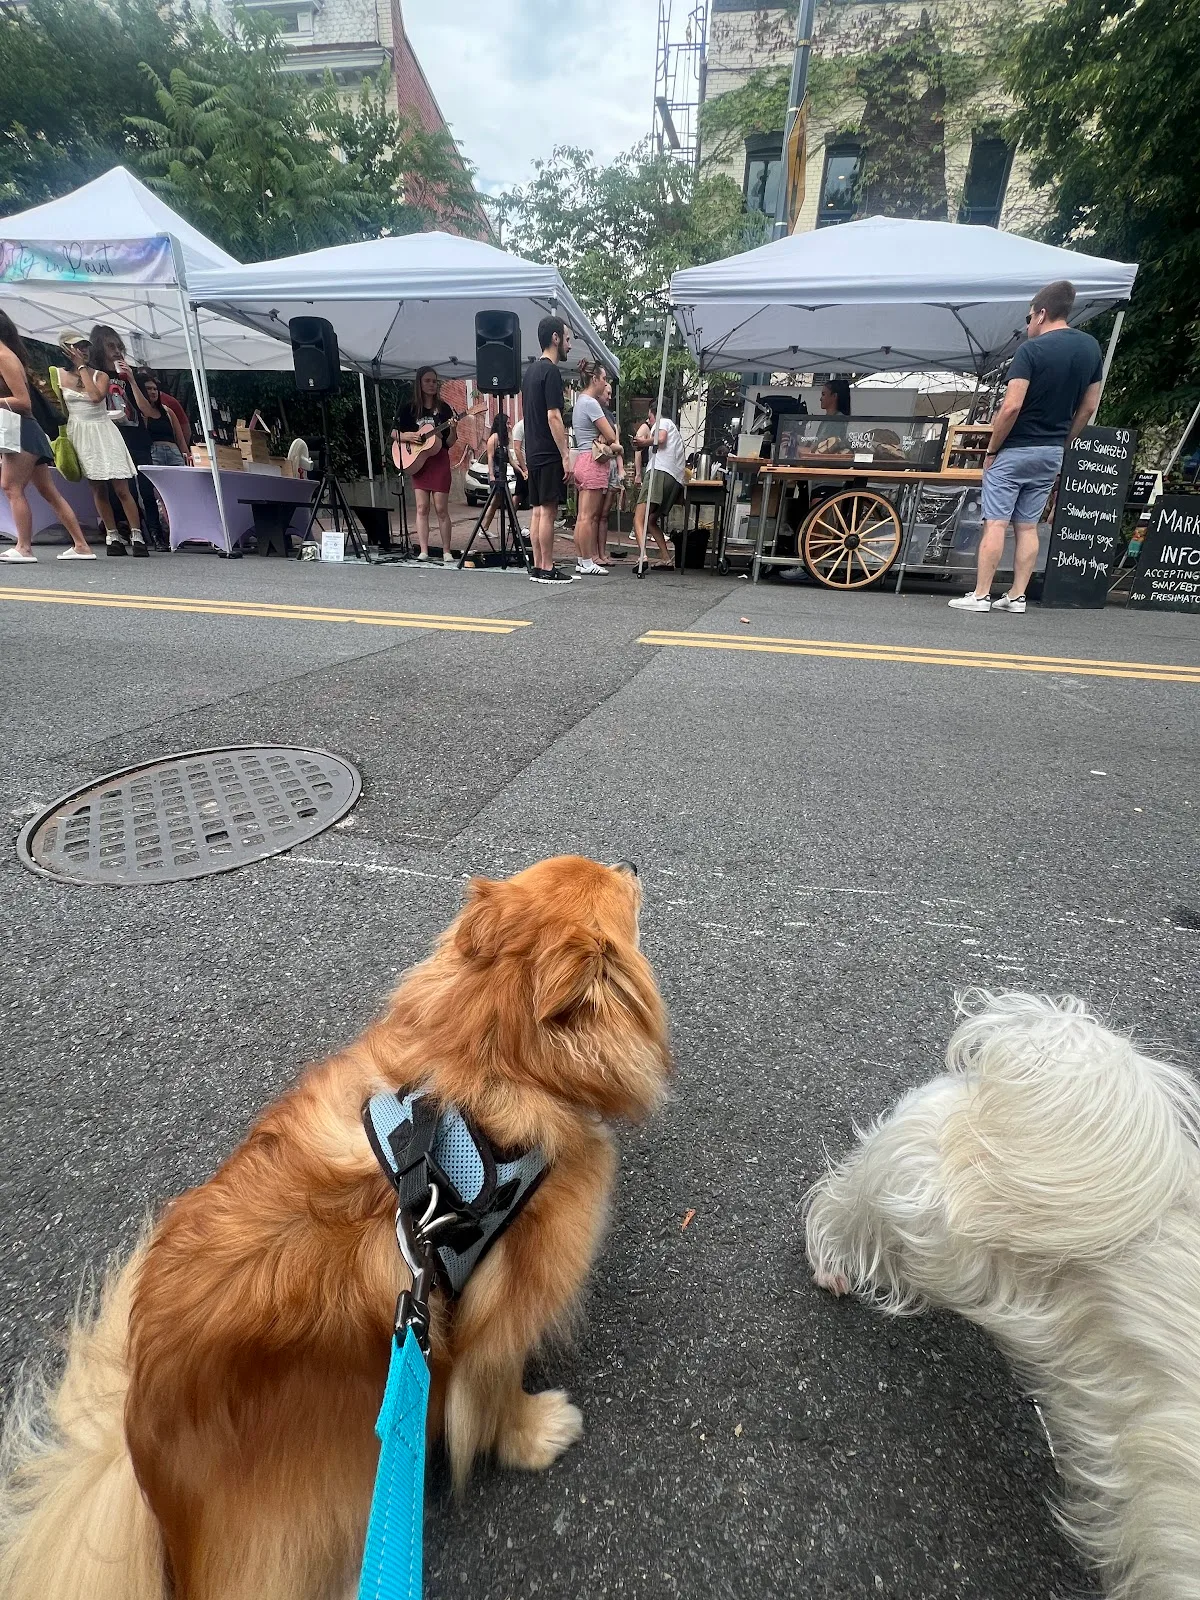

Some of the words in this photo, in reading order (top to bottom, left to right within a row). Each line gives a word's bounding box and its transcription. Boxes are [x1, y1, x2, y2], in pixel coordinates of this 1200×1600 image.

[46, 256, 64, 273] in
[62, 241, 114, 279] Paint
[1115, 430, 1130, 444] $10
[1077, 460, 1118, 476] SPARKLING
[1065, 476, 1119, 496] LEMONADE
[1096, 535, 1114, 553] sage
[1160, 544, 1200, 566] INFO
[1088, 556, 1109, 580] thyme
[1143, 568, 1200, 580] ACCEPTING
[1151, 581, 1200, 593] SNAP/EBT
[1130, 592, 1146, 600] AND
